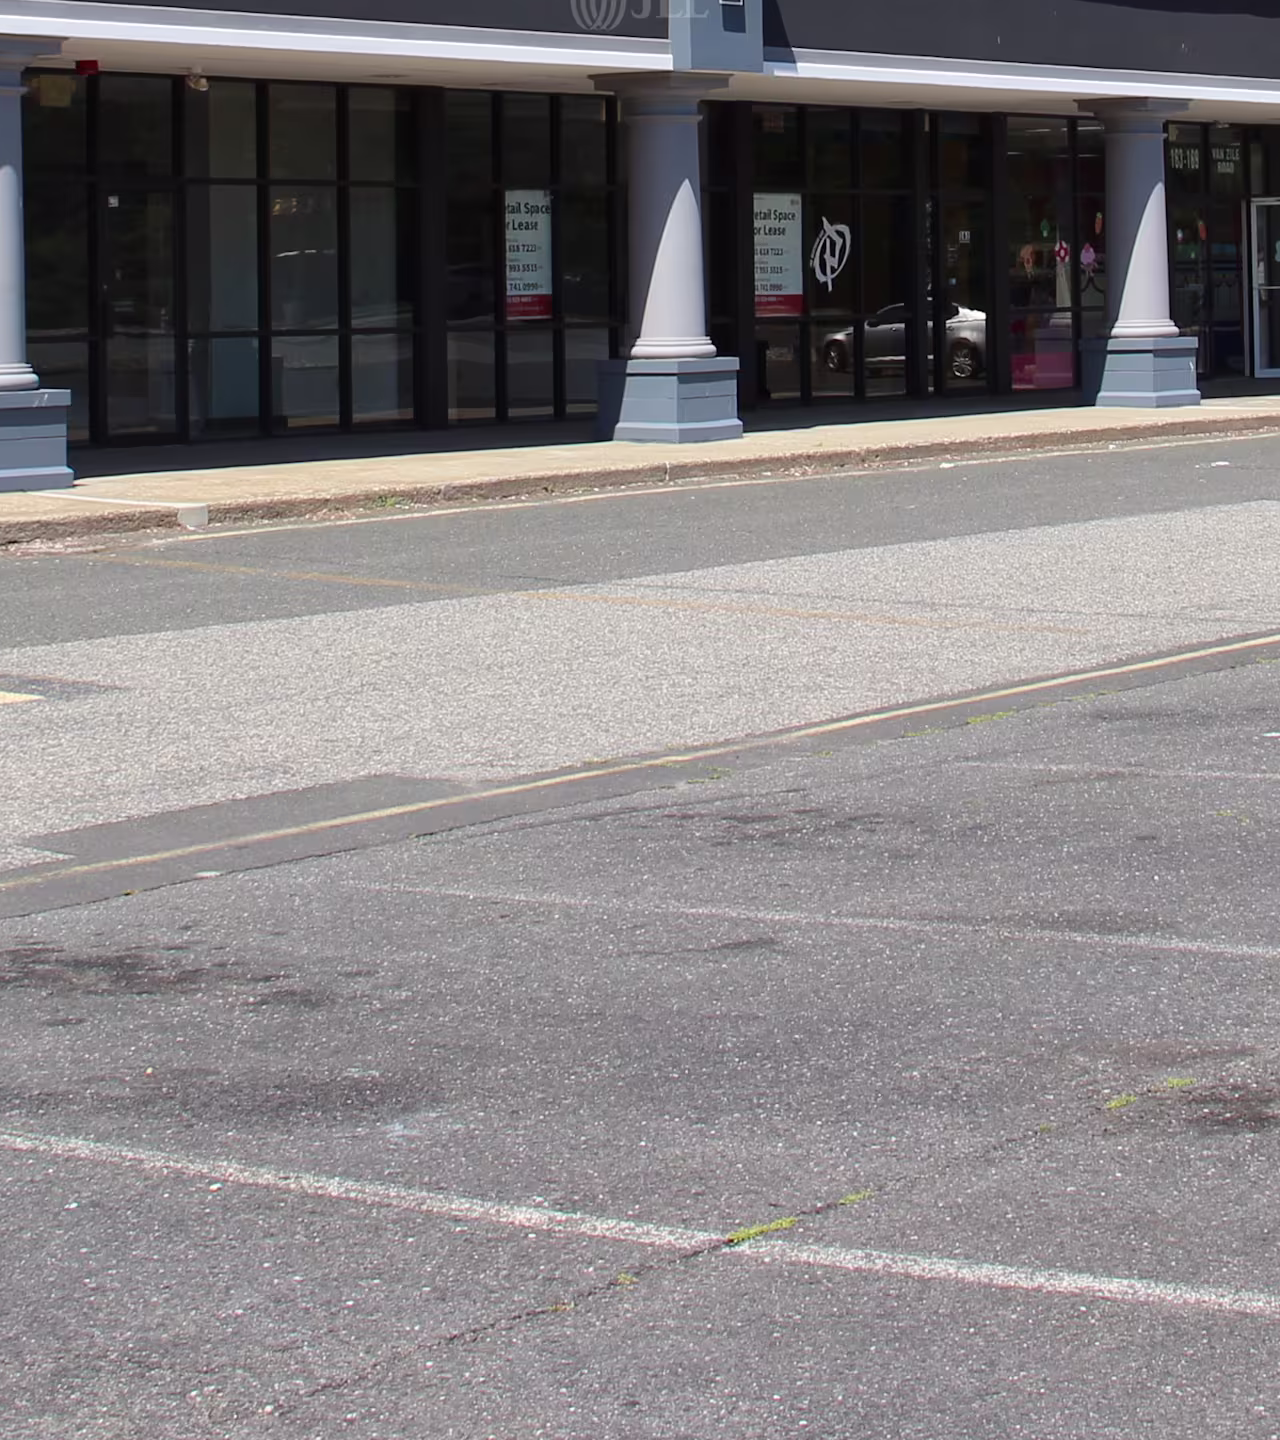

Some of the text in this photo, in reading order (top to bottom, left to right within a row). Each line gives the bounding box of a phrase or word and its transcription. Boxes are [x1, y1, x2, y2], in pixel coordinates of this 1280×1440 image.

[505, 202, 551, 216] tail Space
[773, 209, 796, 222] Space
[512, 219, 538, 231] Lease
[764, 225, 786, 236] Lease
